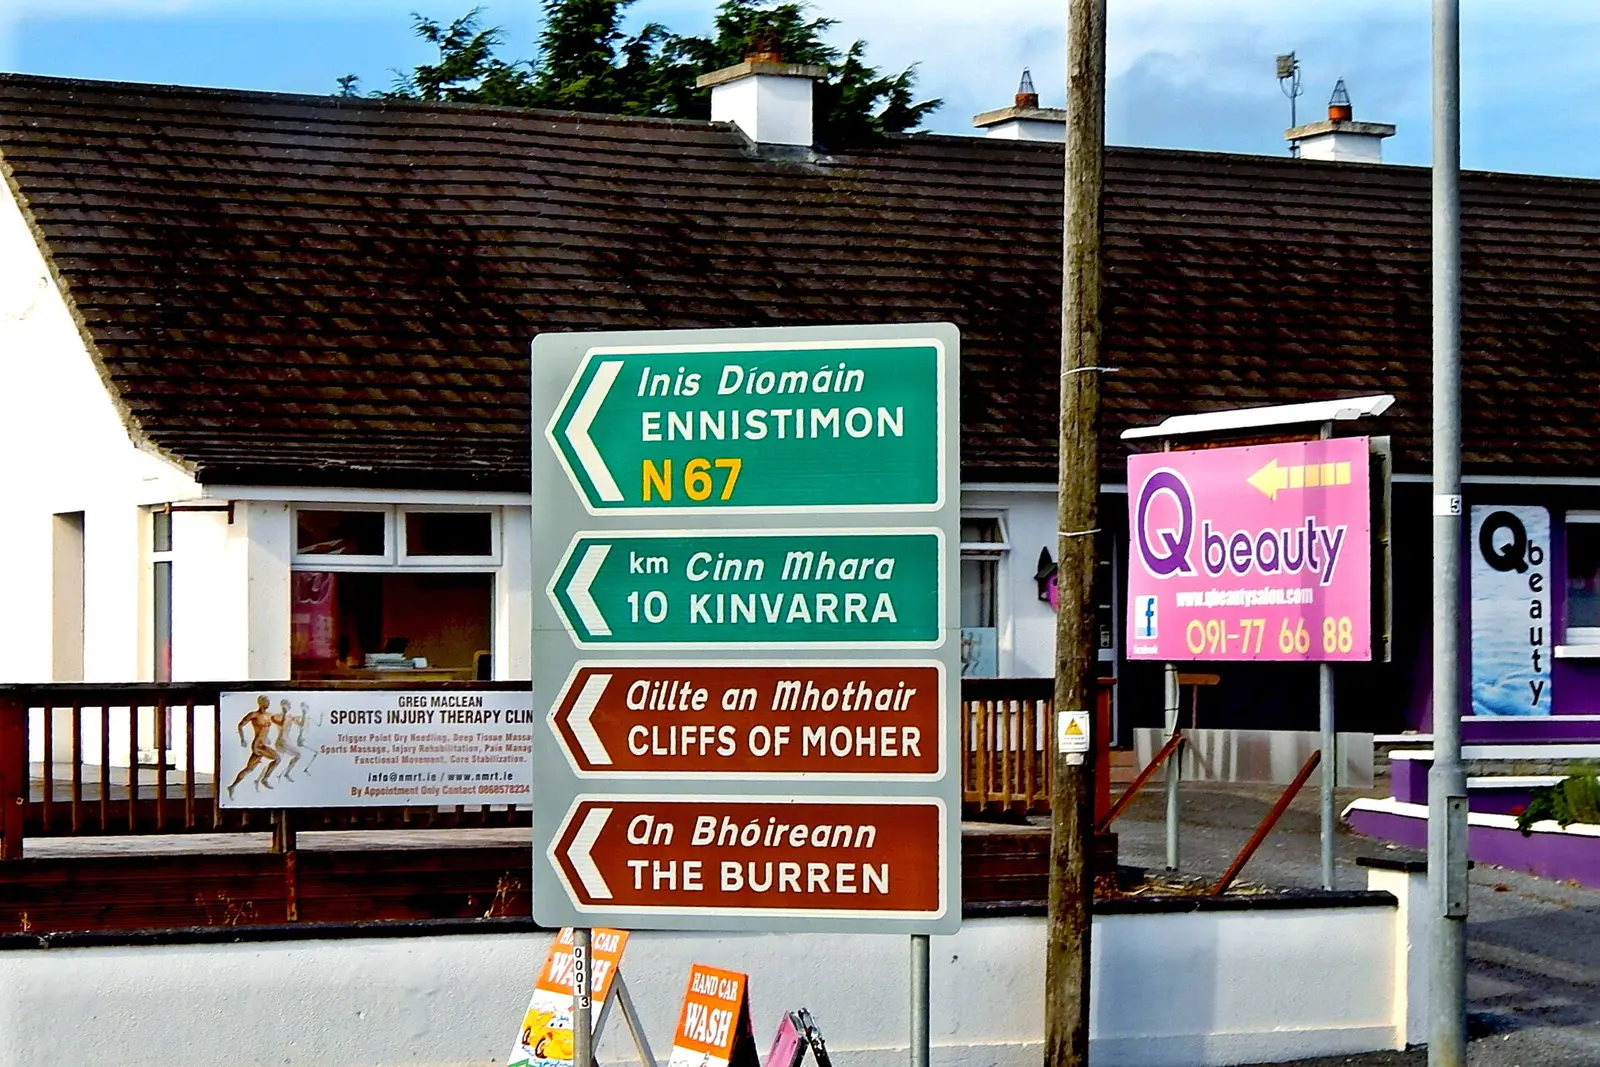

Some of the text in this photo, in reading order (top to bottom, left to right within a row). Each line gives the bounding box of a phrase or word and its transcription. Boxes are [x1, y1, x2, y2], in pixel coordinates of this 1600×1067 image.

[637, 362, 865, 397] Inis Díomáin
[642, 406, 904, 442] ENNISTIMON
[642, 458, 742, 502] N 67
[1135, 466, 1348, 586] Q beauty
[1478, 510, 1529, 574] Q
[630, 551, 896, 582] km Cinn Mhara
[627, 590, 898, 624] 10 KINVARRA
[1186, 616, 1353, 655] 091-77 66 88
[398, 696, 483, 708] GREG MACLEAN
[626, 679, 917, 712] Aillte an Mhothair
[330, 710, 383, 725] SPORTS
[386, 710, 435, 724] INJURY
[439, 709, 501, 724] THERAPY
[320, 744, 348, 755] Sports
[392, 744, 417, 755] Injury
[485, 744, 503, 753] Pain
[337, 733, 367, 743] Trigger
[369, 733, 392, 742] Point
[394, 733, 408, 743] Dry
[453, 733, 474, 743] Deep
[476, 732, 503, 742] Tissue
[627, 724, 921, 757] CLIFFS OF MOHER
[354, 755, 399, 765] Functional
[450, 755, 469, 764] Core
[350, 786, 363, 798] By
[364, 786, 419, 798] Appointment
[421, 785, 440, 797] Only
[442, 784, 477, 795] Contact
[627, 814, 877, 848] An Bhóireann
[627, 859, 889, 894] THE BURREN
[594, 932, 621, 953] CAR
[549, 951, 612, 992] WAH
[691, 971, 739, 1001] HAND CAR
[683, 1001, 733, 1047] WASH
